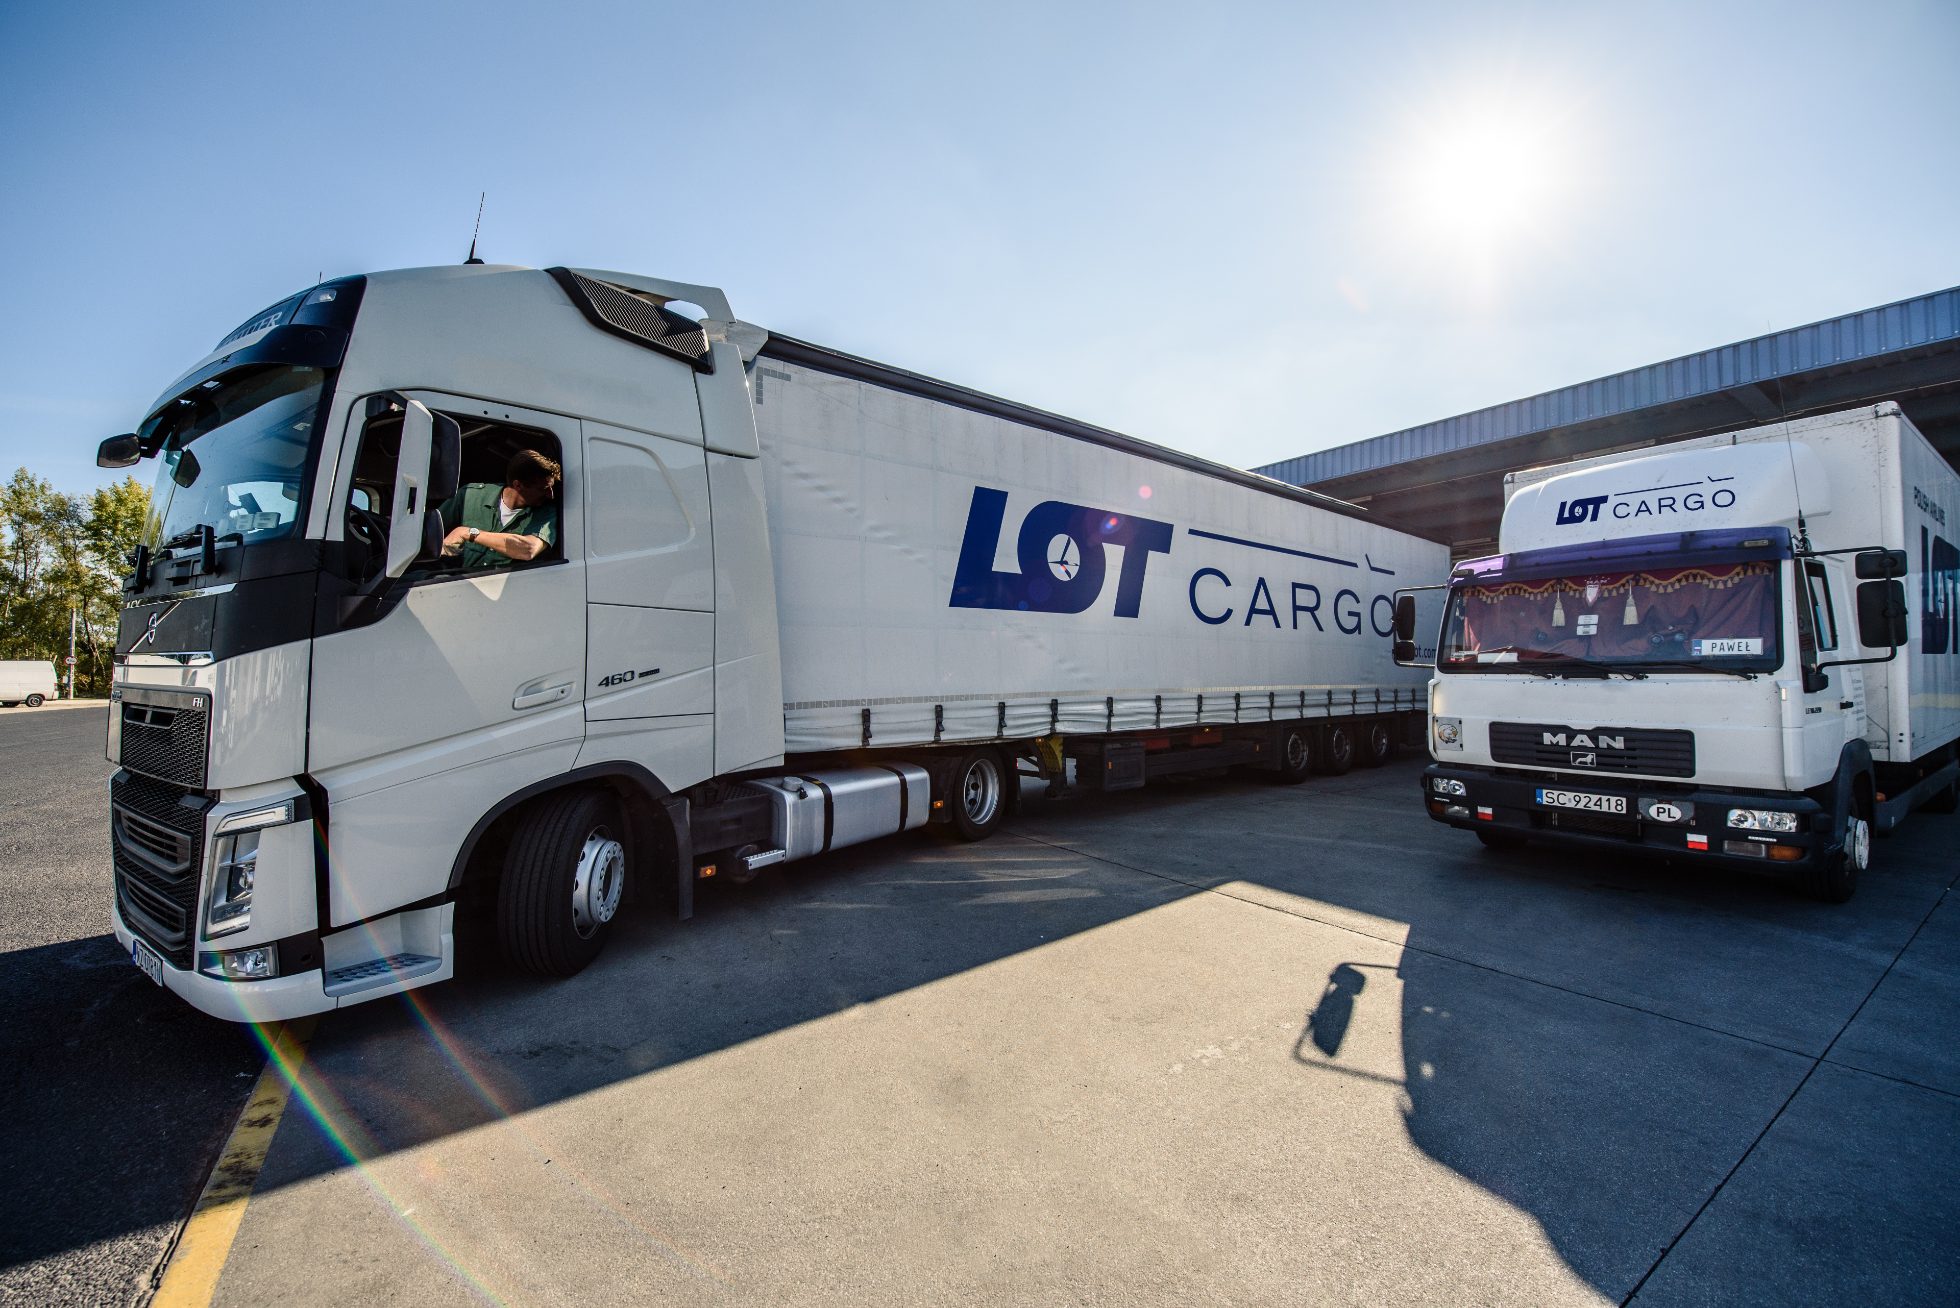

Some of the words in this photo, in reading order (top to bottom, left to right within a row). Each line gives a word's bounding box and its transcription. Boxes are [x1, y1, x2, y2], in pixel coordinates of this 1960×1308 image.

[1556, 495, 1609, 525] LOT
[1613, 489, 1736, 519] CARGO
[949, 485, 1175, 619] LOT
[1188, 567, 1395, 637] CARGO
[1711, 641, 1751, 652] PAWEŁ
[598, 670, 635, 687] 460
[193, 698, 203, 707] FH
[1543, 732, 1625, 750] MAN
[1545, 792, 1567, 806] SC
[1573, 794, 1624, 812] 92418
[1656, 806, 1677, 819] PL
